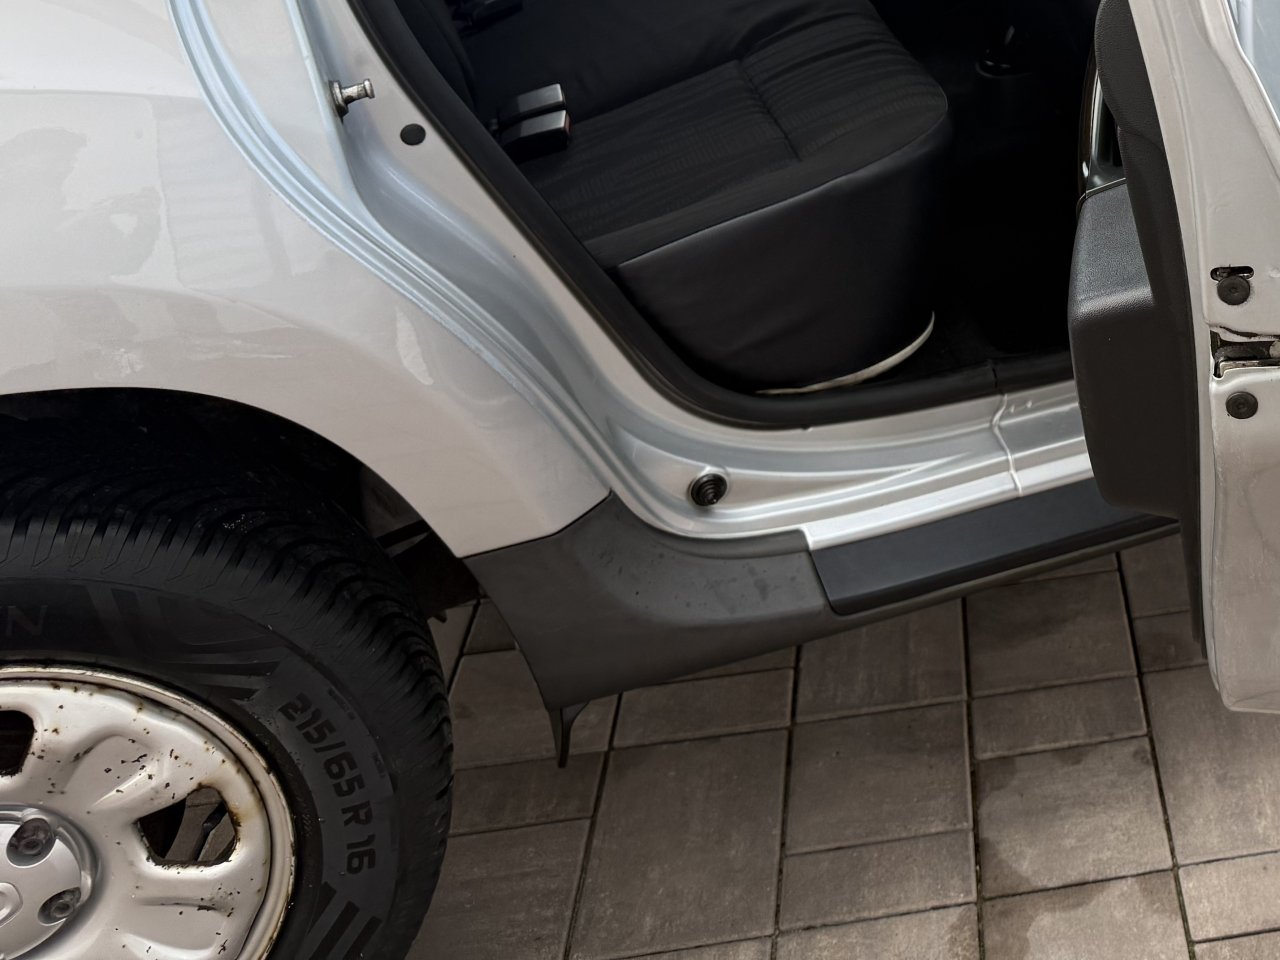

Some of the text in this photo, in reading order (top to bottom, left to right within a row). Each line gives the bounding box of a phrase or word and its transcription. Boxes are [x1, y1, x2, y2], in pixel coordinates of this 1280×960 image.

[278, 692, 366, 798] 215/65
[341, 800, 374, 827] R
[346, 833, 377, 875] 16
